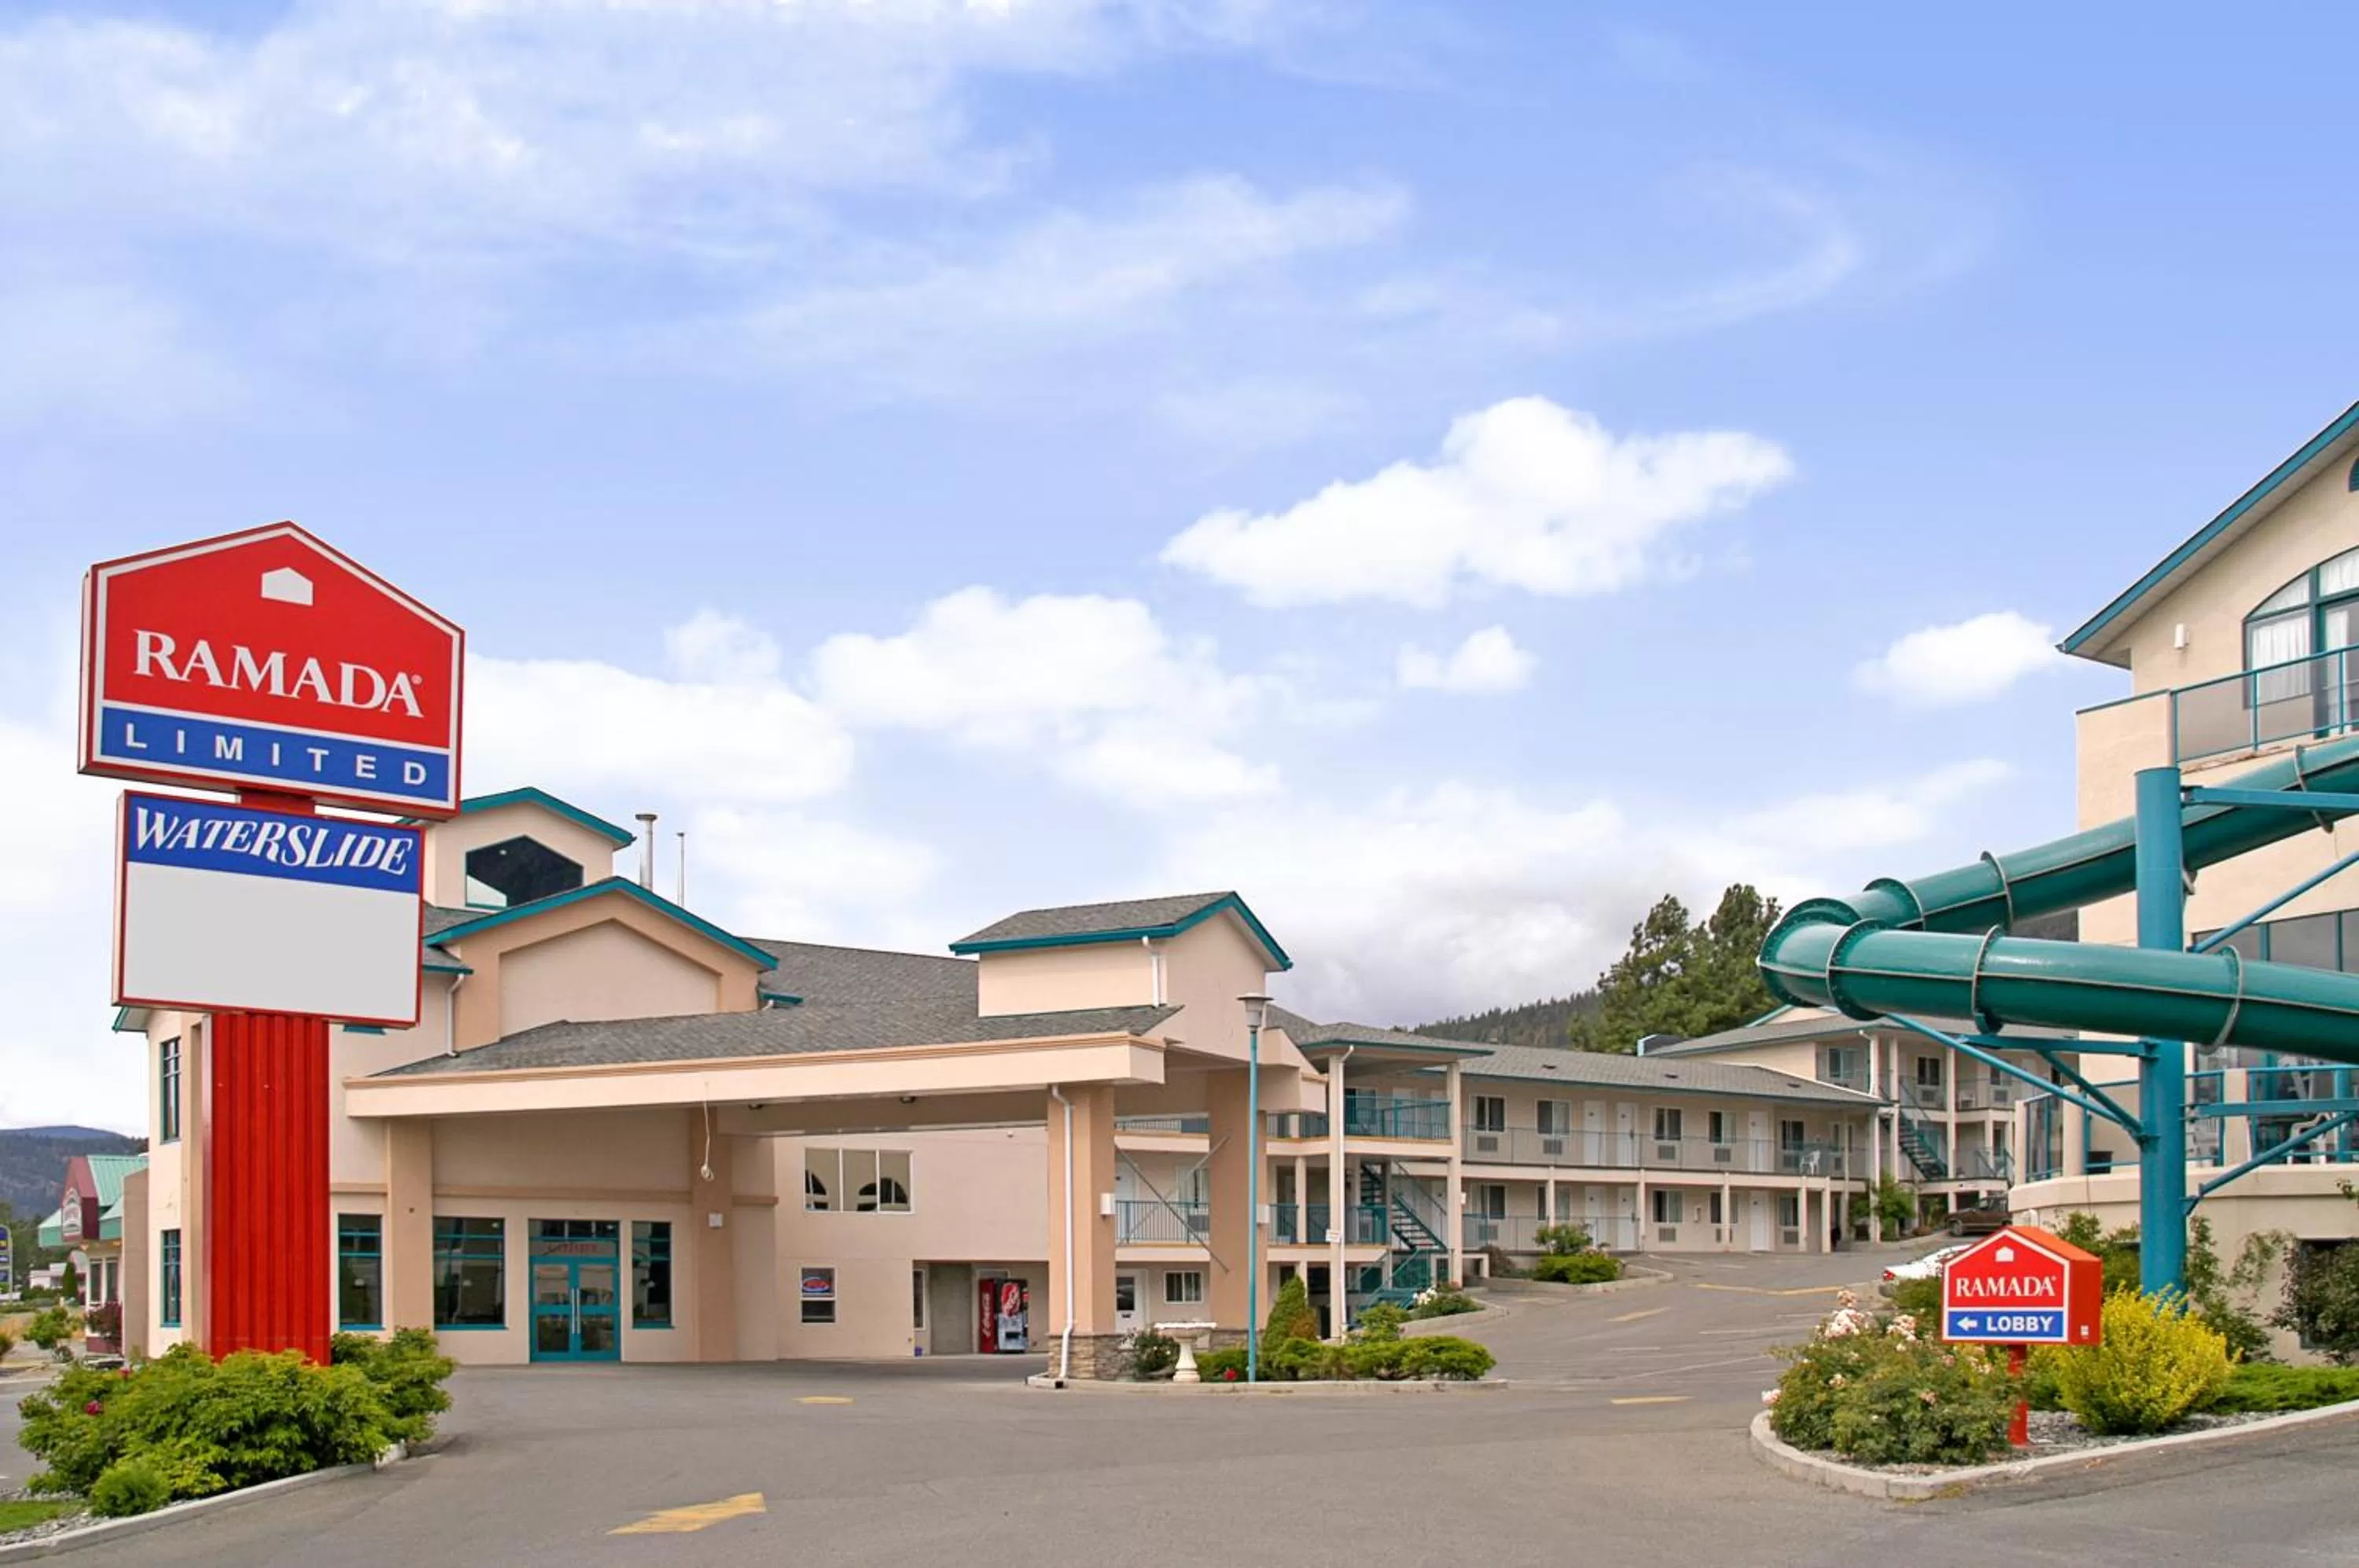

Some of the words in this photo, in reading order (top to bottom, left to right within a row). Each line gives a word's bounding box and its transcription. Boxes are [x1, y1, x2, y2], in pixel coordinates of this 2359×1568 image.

[134, 630, 424, 718] RAMADA
[126, 723, 426, 785] LIMITED
[136, 807, 413, 875] WATERSLIDE
[1955, 1275, 2057, 1297] RAMADA
[1986, 1316, 2053, 1332] LOBBY
